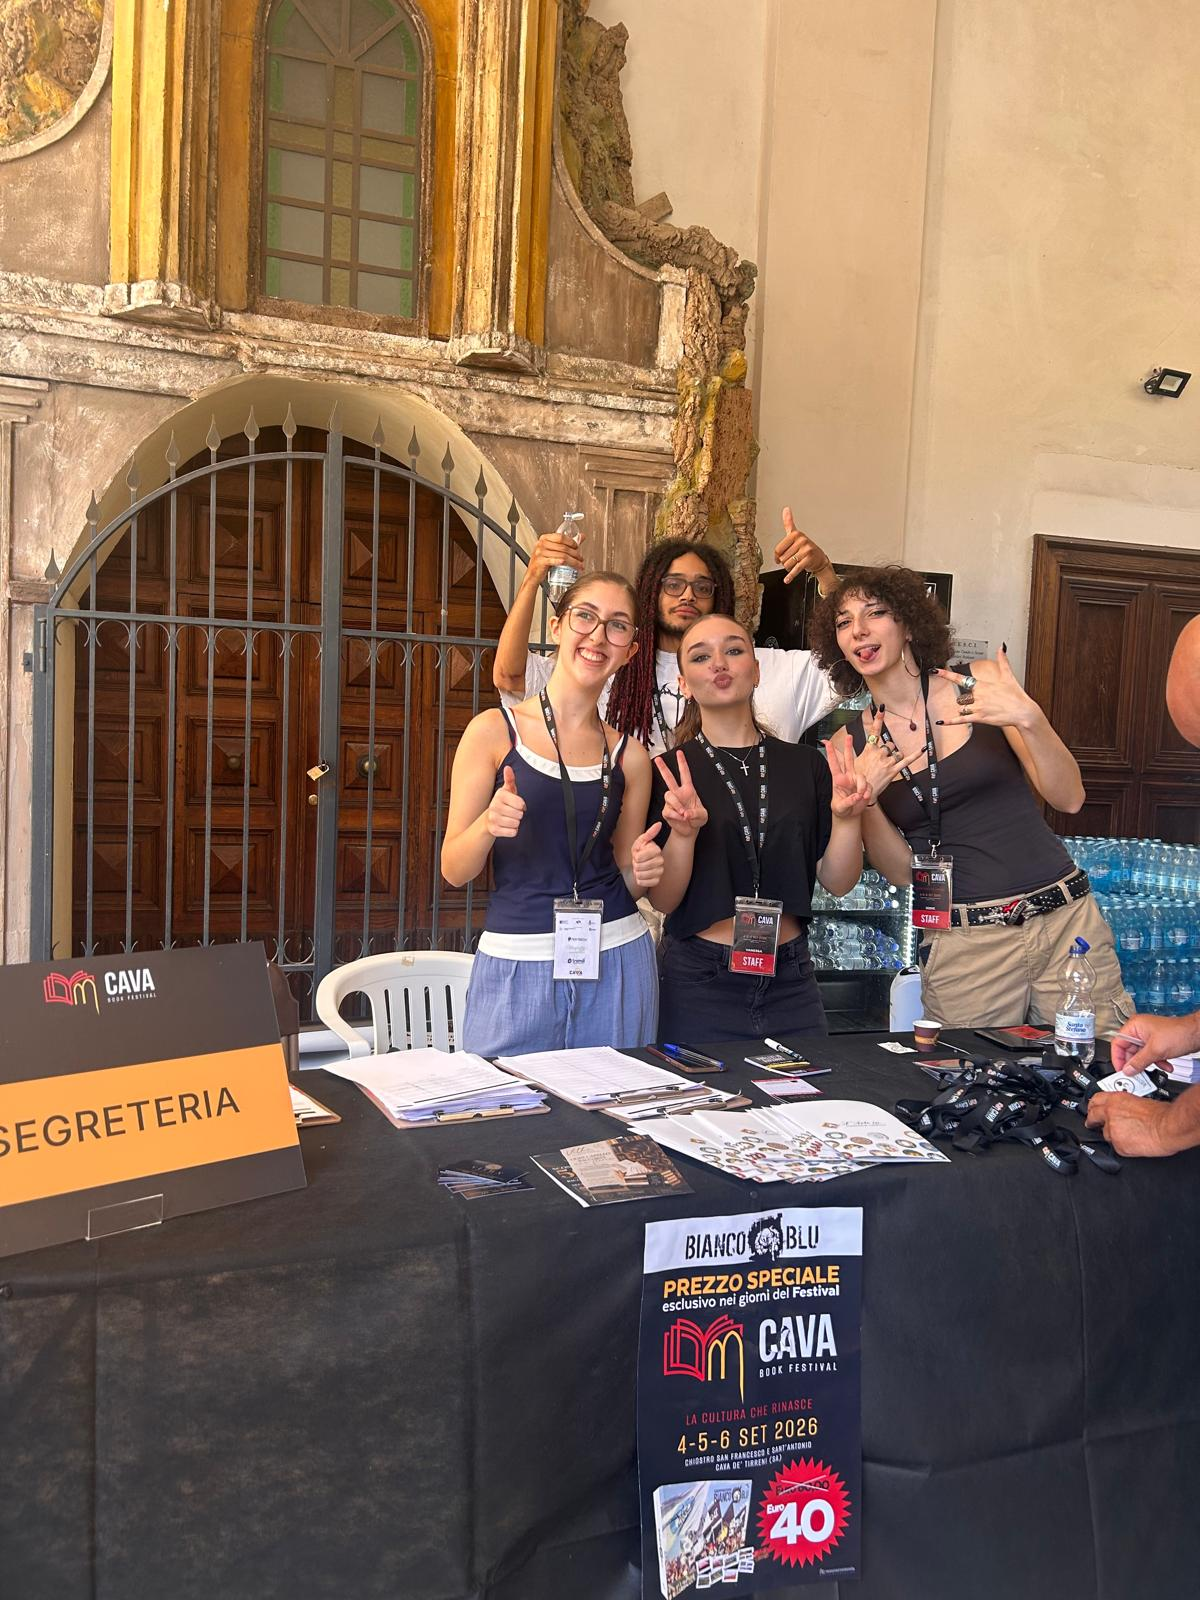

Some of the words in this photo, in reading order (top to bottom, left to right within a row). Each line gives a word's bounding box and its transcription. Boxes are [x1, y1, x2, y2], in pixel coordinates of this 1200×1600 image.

[758, 916, 774, 925] CAVA
[921, 914, 940, 924] STAFF
[742, 956, 764, 967] STAFF
[104, 968, 156, 995] CAVA
[127, 992, 157, 1000] FESTIVAL
[1049, 1152, 1061, 1167] CAVA
[685, 1231, 745, 1260] BIANCO
[786, 1225, 819, 1250] BLU
[663, 1274, 743, 1298] PREZZO
[748, 1265, 840, 1291] SPECIALE
[662, 1297, 716, 1312] esclusivo
[719, 1294, 736, 1306] nei
[739, 1291, 770, 1307] giorni
[773, 1287, 790, 1300] del
[792, 1284, 840, 1299] Festival
[759, 1313, 838, 1362] CAVA
[759, 1365, 783, 1378] BOOK
[789, 1362, 838, 1373] FESTIVAL
[686, 1413, 697, 1426] LA
[702, 1408, 747, 1423] CULTURA
[750, 1405, 768, 1418] CHE
[771, 1398, 813, 1414] RINASCE
[677, 1430, 730, 1454] 4-5-6
[739, 1424, 767, 1447] SET
[775, 1417, 818, 1440] 2026
[684, 1455, 715, 1467] CHIOSTRO
[716, 1453, 729, 1462] SAN
[731, 1449, 765, 1460] FRANCESCO
[766, 1447, 770, 1455] E
[771, 1441, 812, 1454] SANT'ANTONIO
[715, 1461, 731, 1472] CAVA
[732, 1460, 743, 1470] DE'
[745, 1457, 768, 1468] TIRRENI
[769, 1453, 783, 1465] (SA)
[767, 1503, 784, 1515] Euro
[770, 1499, 835, 1545] 40
